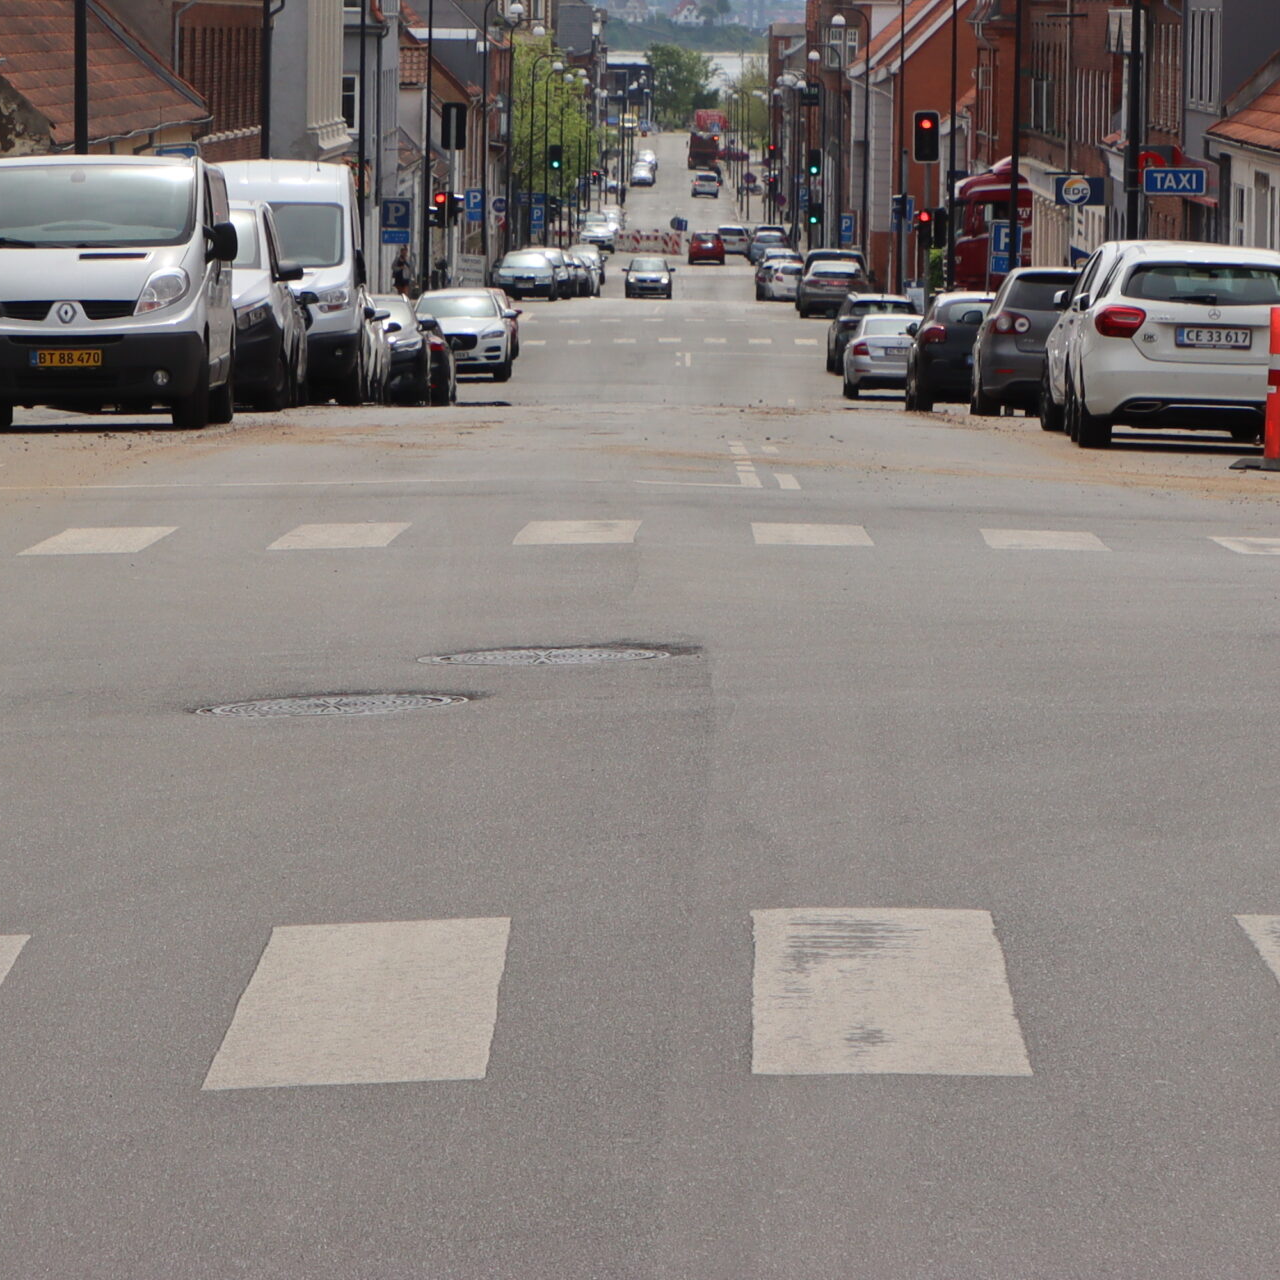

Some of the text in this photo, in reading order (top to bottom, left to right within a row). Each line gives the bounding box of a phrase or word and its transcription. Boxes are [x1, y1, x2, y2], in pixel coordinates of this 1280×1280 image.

[1153, 173, 1197, 190] TAXI
[1064, 187, 1090, 196] EDC
[470, 192, 482, 208] P
[386, 202, 406, 225] P
[533, 209, 542, 220] P
[842, 218, 851, 229] P
[1186, 330, 1249, 344] CE 33 617
[38, 352, 100, 365] BT 88 470
